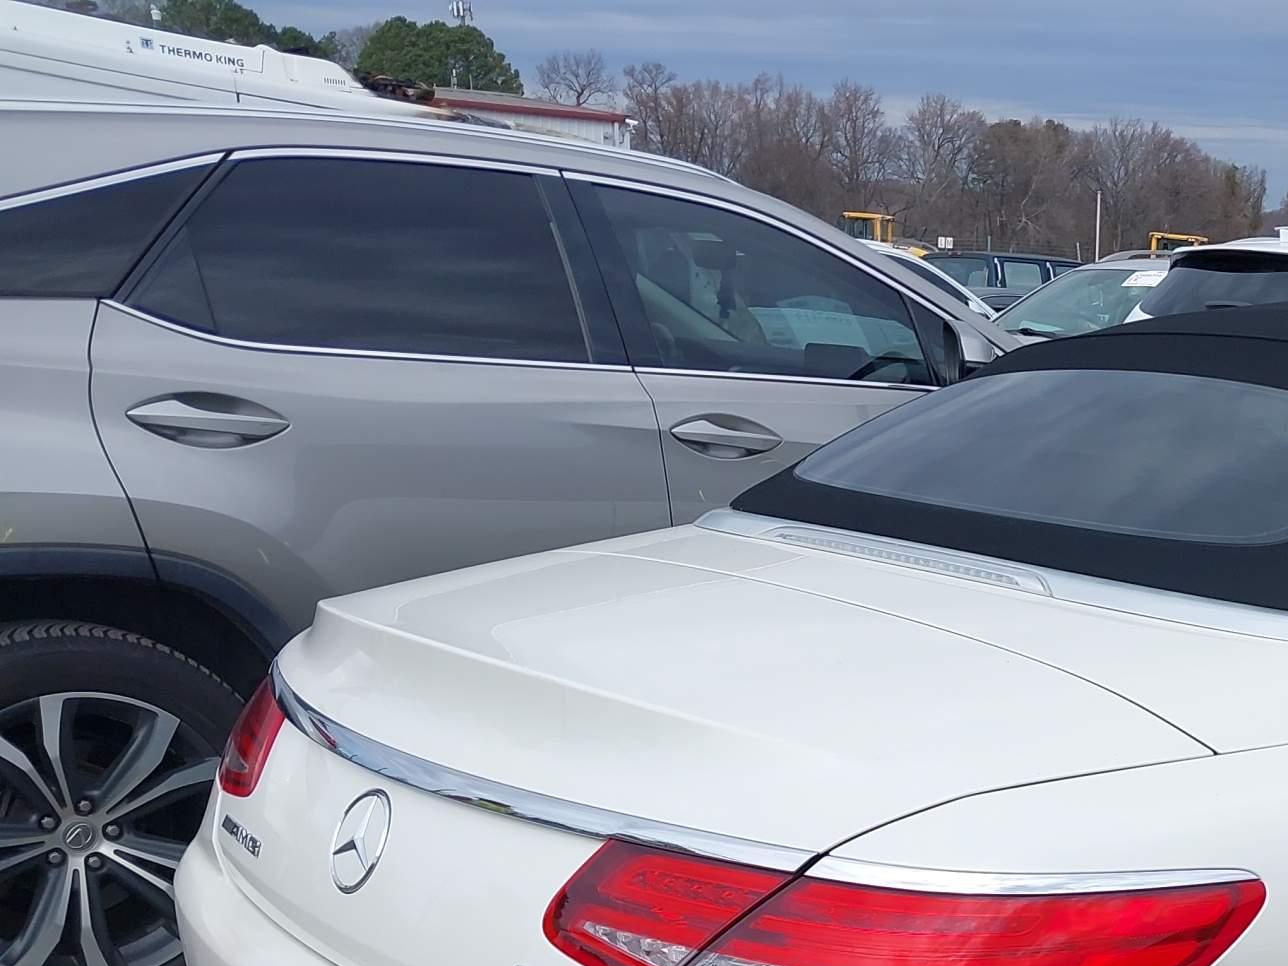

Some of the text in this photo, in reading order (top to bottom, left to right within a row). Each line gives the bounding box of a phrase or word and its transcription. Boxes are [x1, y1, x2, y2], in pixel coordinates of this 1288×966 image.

[159, 44, 245, 68] THERMO KING
[229, 821, 262, 858] AMG
